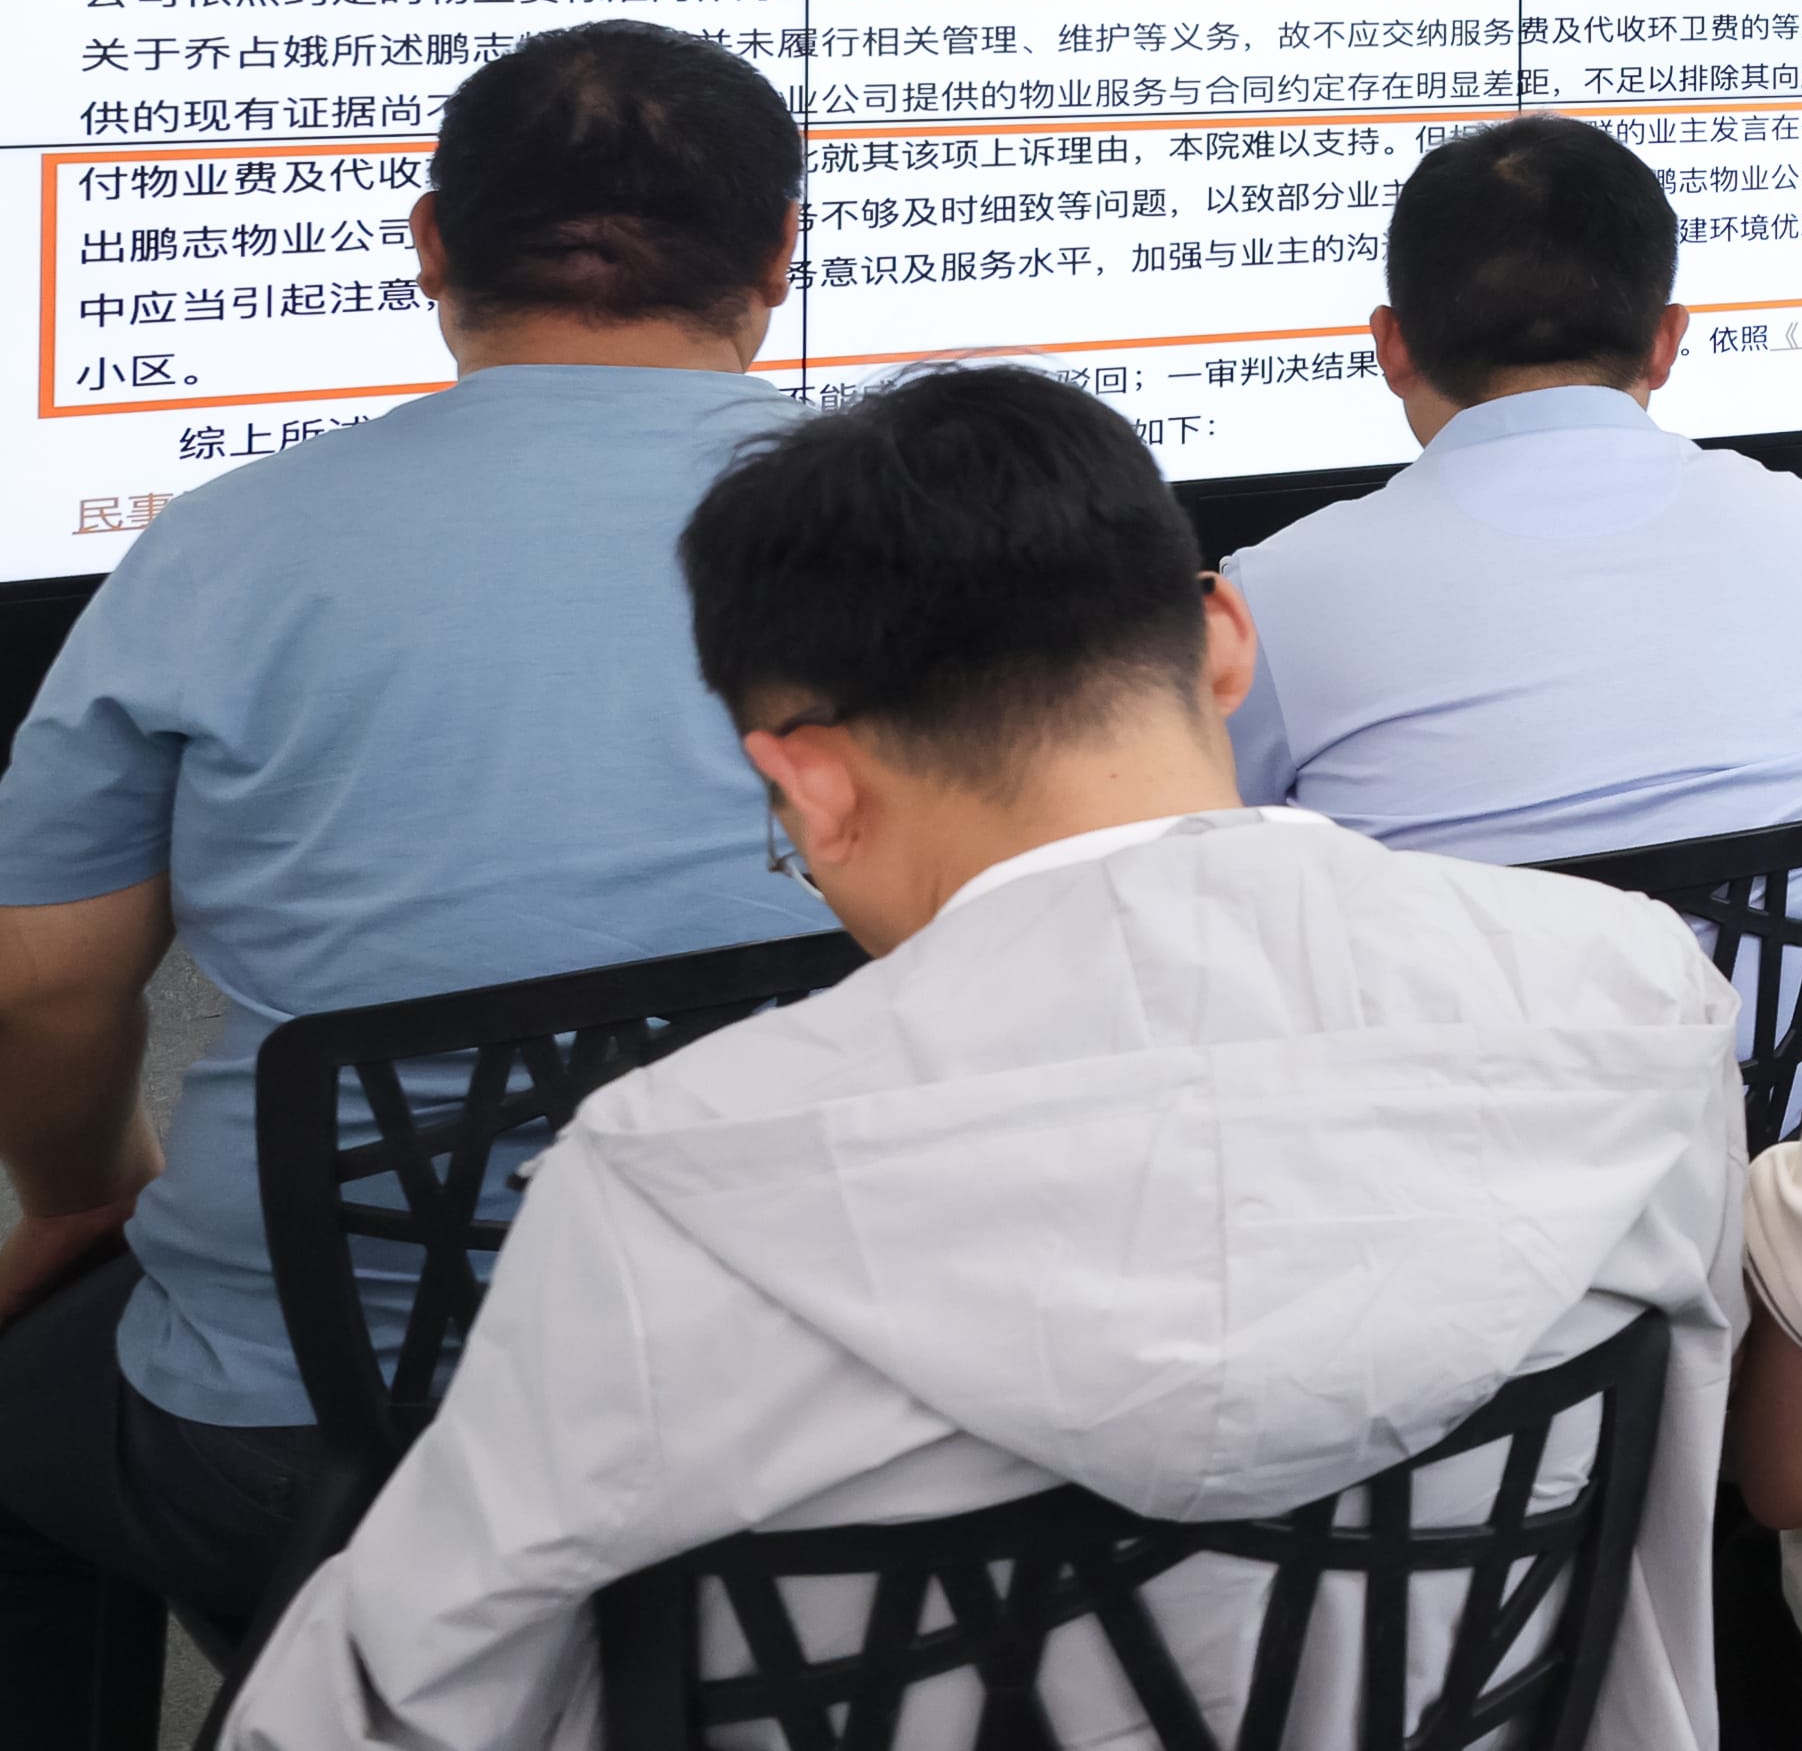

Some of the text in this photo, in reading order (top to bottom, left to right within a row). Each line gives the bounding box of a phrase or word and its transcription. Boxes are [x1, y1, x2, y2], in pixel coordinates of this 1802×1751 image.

[77, 353, 200, 391] 小区。
[179, 415, 370, 460] 综上所
